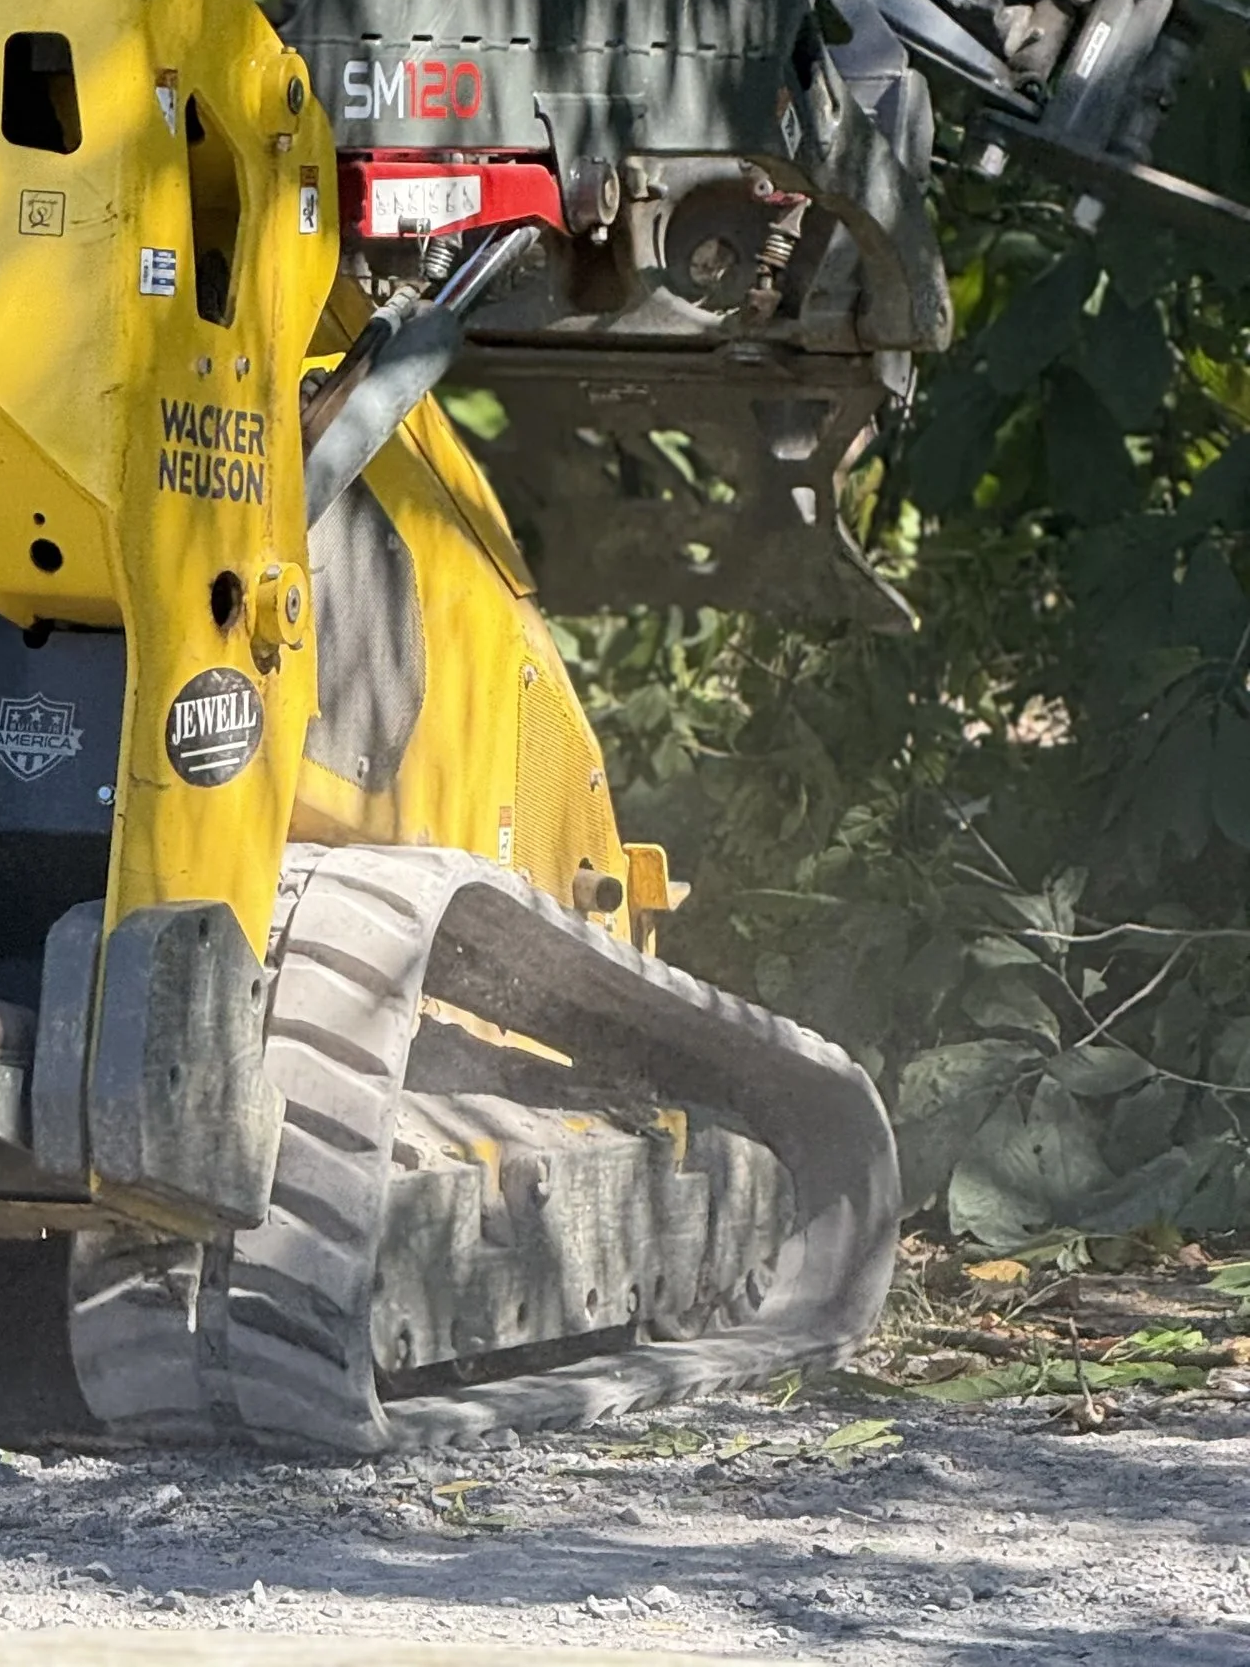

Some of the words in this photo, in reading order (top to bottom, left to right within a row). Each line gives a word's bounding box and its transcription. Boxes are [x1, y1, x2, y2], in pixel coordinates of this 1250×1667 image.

[343, 60, 483, 119] SM120
[160, 397, 265, 457] WACKER
[158, 448, 264, 505] NEUSON
[171, 690, 257, 746] JEWELL
